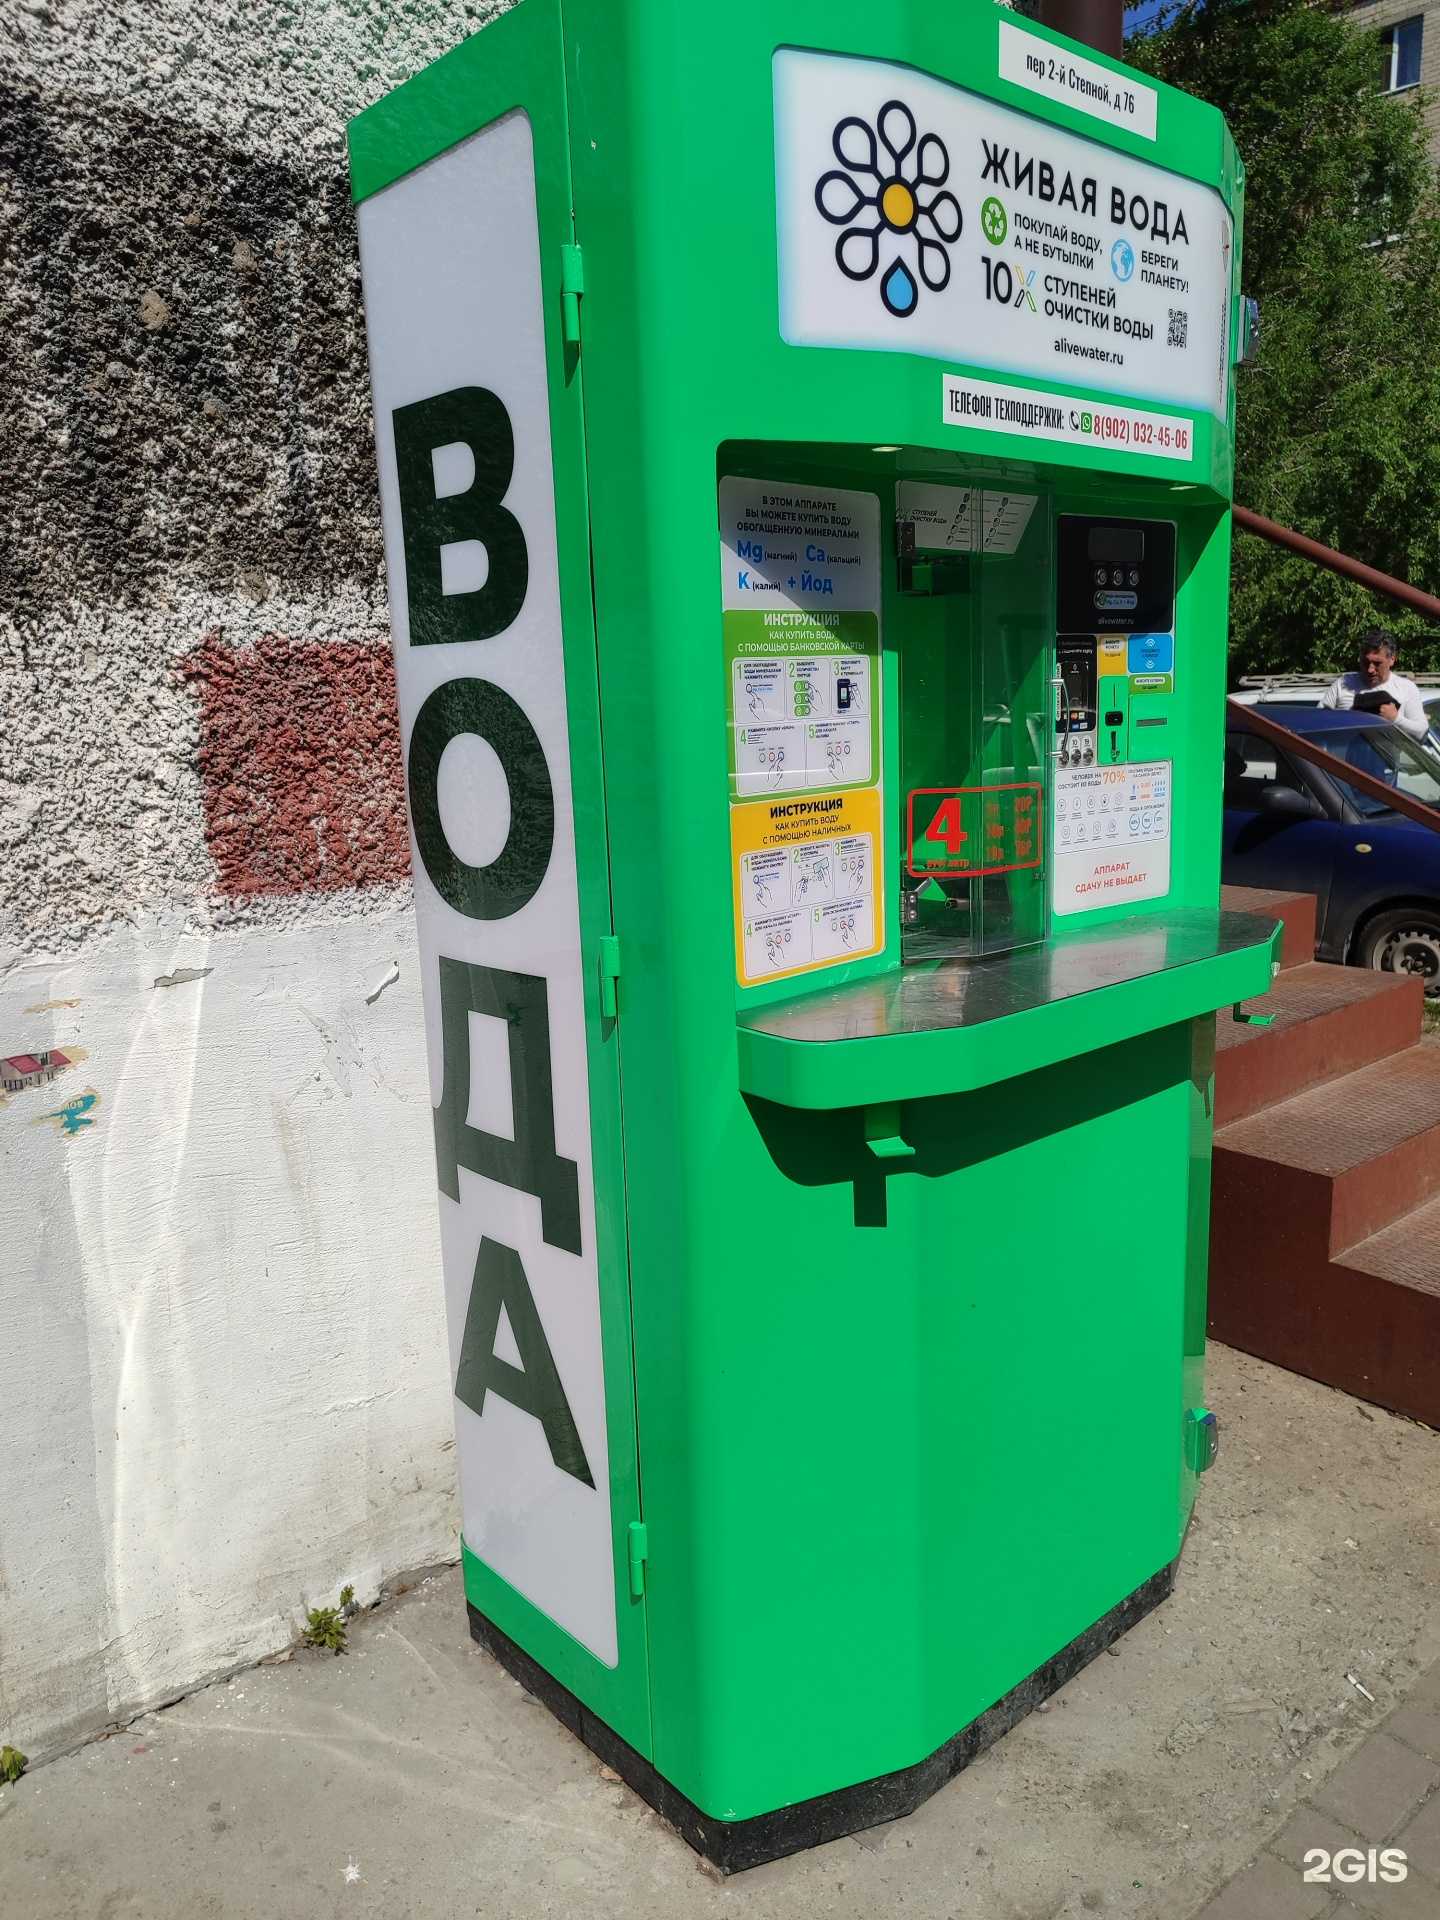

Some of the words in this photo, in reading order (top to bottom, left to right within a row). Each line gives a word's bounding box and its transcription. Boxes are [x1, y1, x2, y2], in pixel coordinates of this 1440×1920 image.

[1026, 54, 1045, 79] пер
[1048, 59, 1066, 85] 2-й
[1068, 68, 1111, 107] Степной,
[1113, 93, 1121, 112] д
[1123, 91, 1135, 114] 76
[981, 138, 1097, 217] ЖИВАЯ
[1110, 186, 1190, 246] ВОДА
[1014, 212, 1068, 242] ПОКУПАЙ
[1071, 231, 1103, 256] ВОДУ,
[1014, 234, 1022, 249] А
[1025, 237, 1040, 255] НЕ
[1042, 243, 1094, 270] БУТЫЛКИ
[1141, 250, 1179, 271] БЕРЕГИ
[1044, 274, 1116, 309] СТУПЕНЕЙ
[1140, 269, 1189, 294] ПЛАНЕТУ!
[1044, 299, 1110, 330] ОЧИСТКИ
[1113, 315, 1154, 340] ВОДЫ
[1053, 337, 1124, 366] alivewater.ru
[949, 389, 992, 418] ТЕЛЕФОН
[994, 397, 1065, 430] ТЕХПОДДЕРЖКИ:
[1094, 414, 1130, 444] 8(902)
[1133, 421, 1188, 449] 032-45-06
[769, 497, 793, 508] ЭТОМ
[794, 500, 837, 512] АППАРАТЕ
[760, 510, 797, 522] МОЖЕТЕ
[798, 514, 829, 525] КУПИТЬ
[830, 517, 852, 526] ВОДУ
[736, 521, 803, 536] ОБОГАЩЕННУЮ
[804, 527, 860, 540] МИНЕРАЛАМИ
[737, 539, 763, 564] Mg
[801, 570, 833, 595] Йод
[764, 613, 840, 626] ИНСТРУКЦИЯ
[769, 630, 784, 640] КАК
[785, 630, 815, 640] КУПИТЬ
[745, 643, 789, 652] ПОМОЩЬЮ
[790, 642, 840, 651] БАНКОВСКОЙ
[788, 662, 796, 678] 2
[834, 660, 841, 676] 3
[740, 729, 747, 744] 4
[808, 725, 816, 739] 5
[1103, 771, 1127, 784] 70%
[770, 798, 843, 819] ИНСТРУКЦИЯ
[775, 820, 790, 831] КАК
[791, 817, 819, 829] КУПИТЬ
[820, 814, 840, 825] ВОДУ
[925, 798, 967, 854] 4
[762, 836, 768, 845] С
[769, 831, 811, 844] ПОМОЩЬЮ
[811, 824, 852, 837] НАЛИЧНЫХ
[834, 841, 841, 856] 3
[1094, 862, 1131, 875] АППАРАТ
[1075, 883, 1102, 893] СДАЧУ
[1103, 880, 1115, 888] НЕ
[1116, 874, 1147, 886] ВЫДАЕТ
[391, 384, 598, 1492] ВОДА
